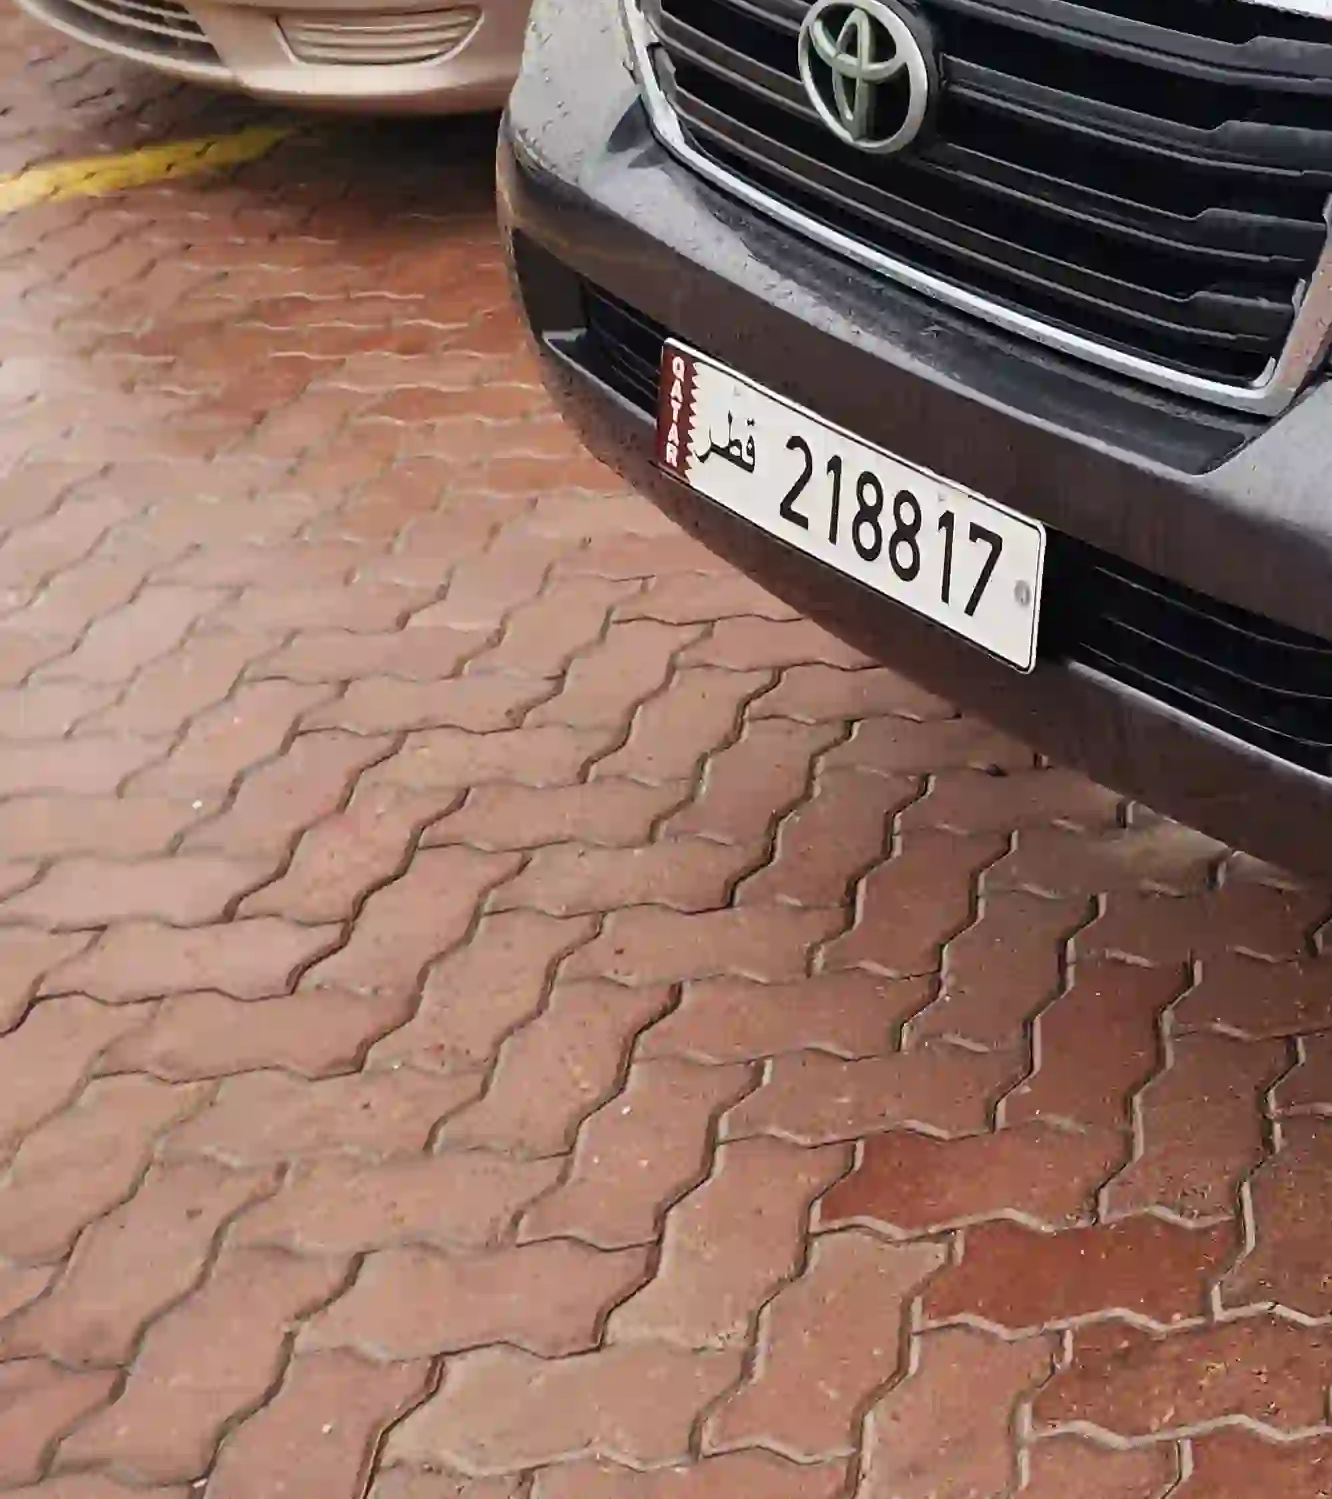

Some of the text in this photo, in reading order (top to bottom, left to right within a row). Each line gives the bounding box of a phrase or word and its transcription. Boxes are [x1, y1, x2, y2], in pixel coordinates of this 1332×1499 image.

[666, 355, 685, 468] QATAR
[693, 410, 756, 474] قطر
[779, 434, 1003, 617] 218817
